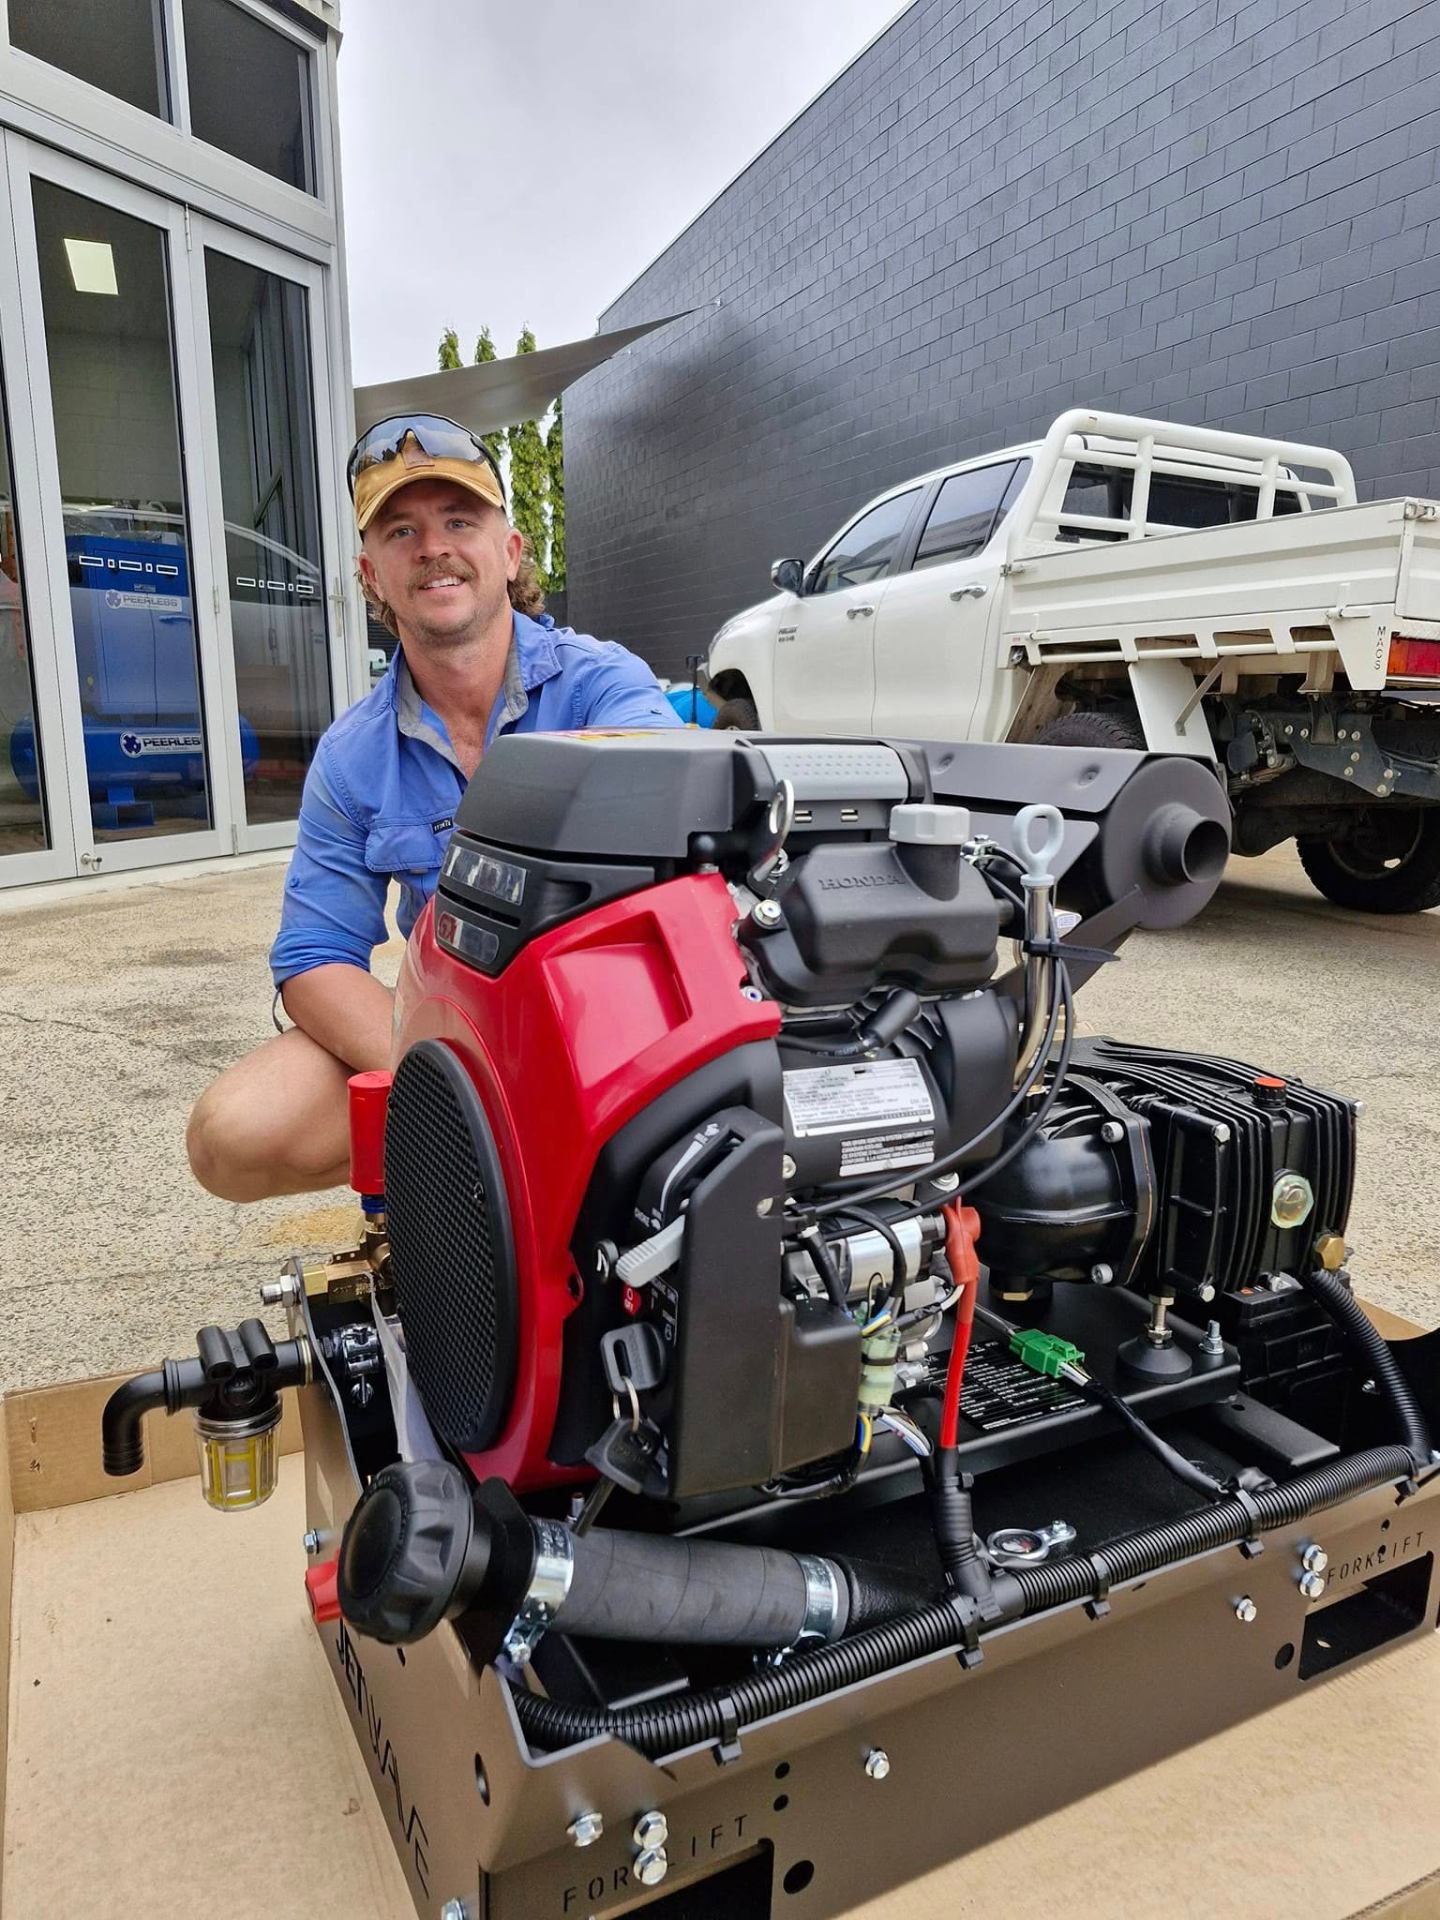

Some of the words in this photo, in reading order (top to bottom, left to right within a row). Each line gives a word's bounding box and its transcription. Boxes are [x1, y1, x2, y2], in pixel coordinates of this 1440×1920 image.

[1374, 626, 1386, 670] MACS
[142, 737, 201, 747] PEERLES
[818, 875, 905, 890] HONDA
[563, 1814, 748, 1913] FORIFT
